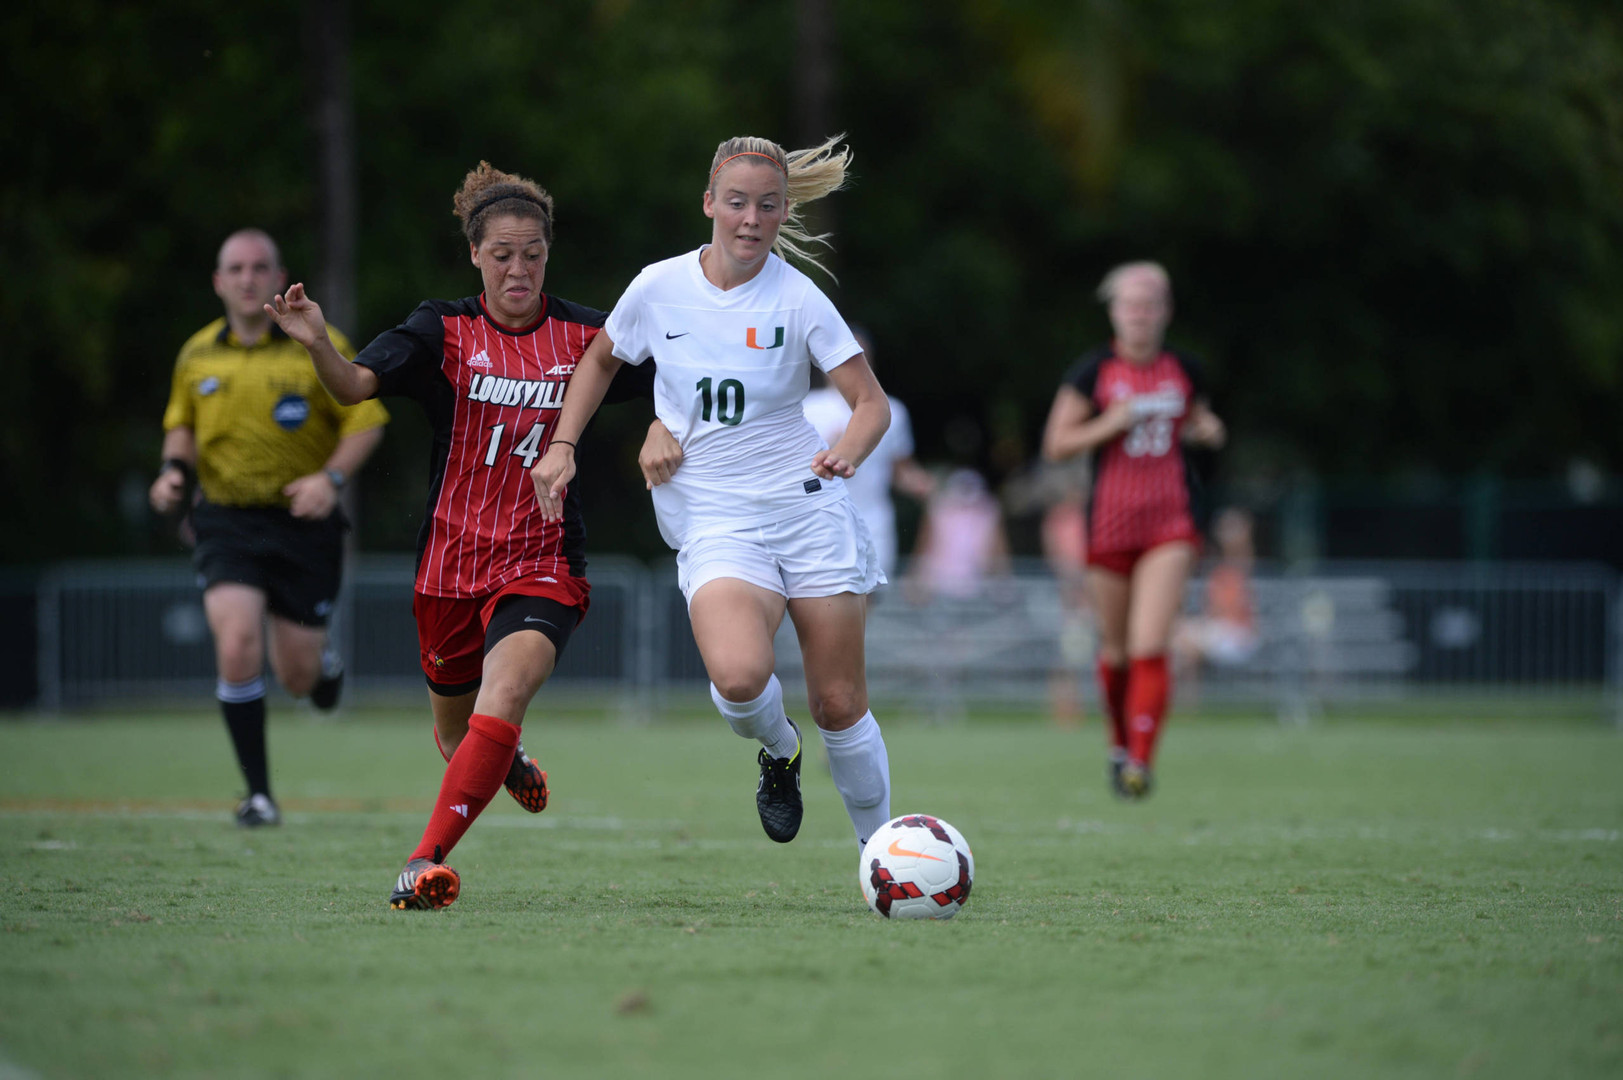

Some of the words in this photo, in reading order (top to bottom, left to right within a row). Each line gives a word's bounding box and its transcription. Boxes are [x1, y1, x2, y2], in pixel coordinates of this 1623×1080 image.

[467, 359, 493, 369] adidas
[545, 364, 576, 376] ACC
[468, 373, 565, 409] LOUISVILL
[696, 377, 745, 426] 10
[485, 423, 546, 468] 14
